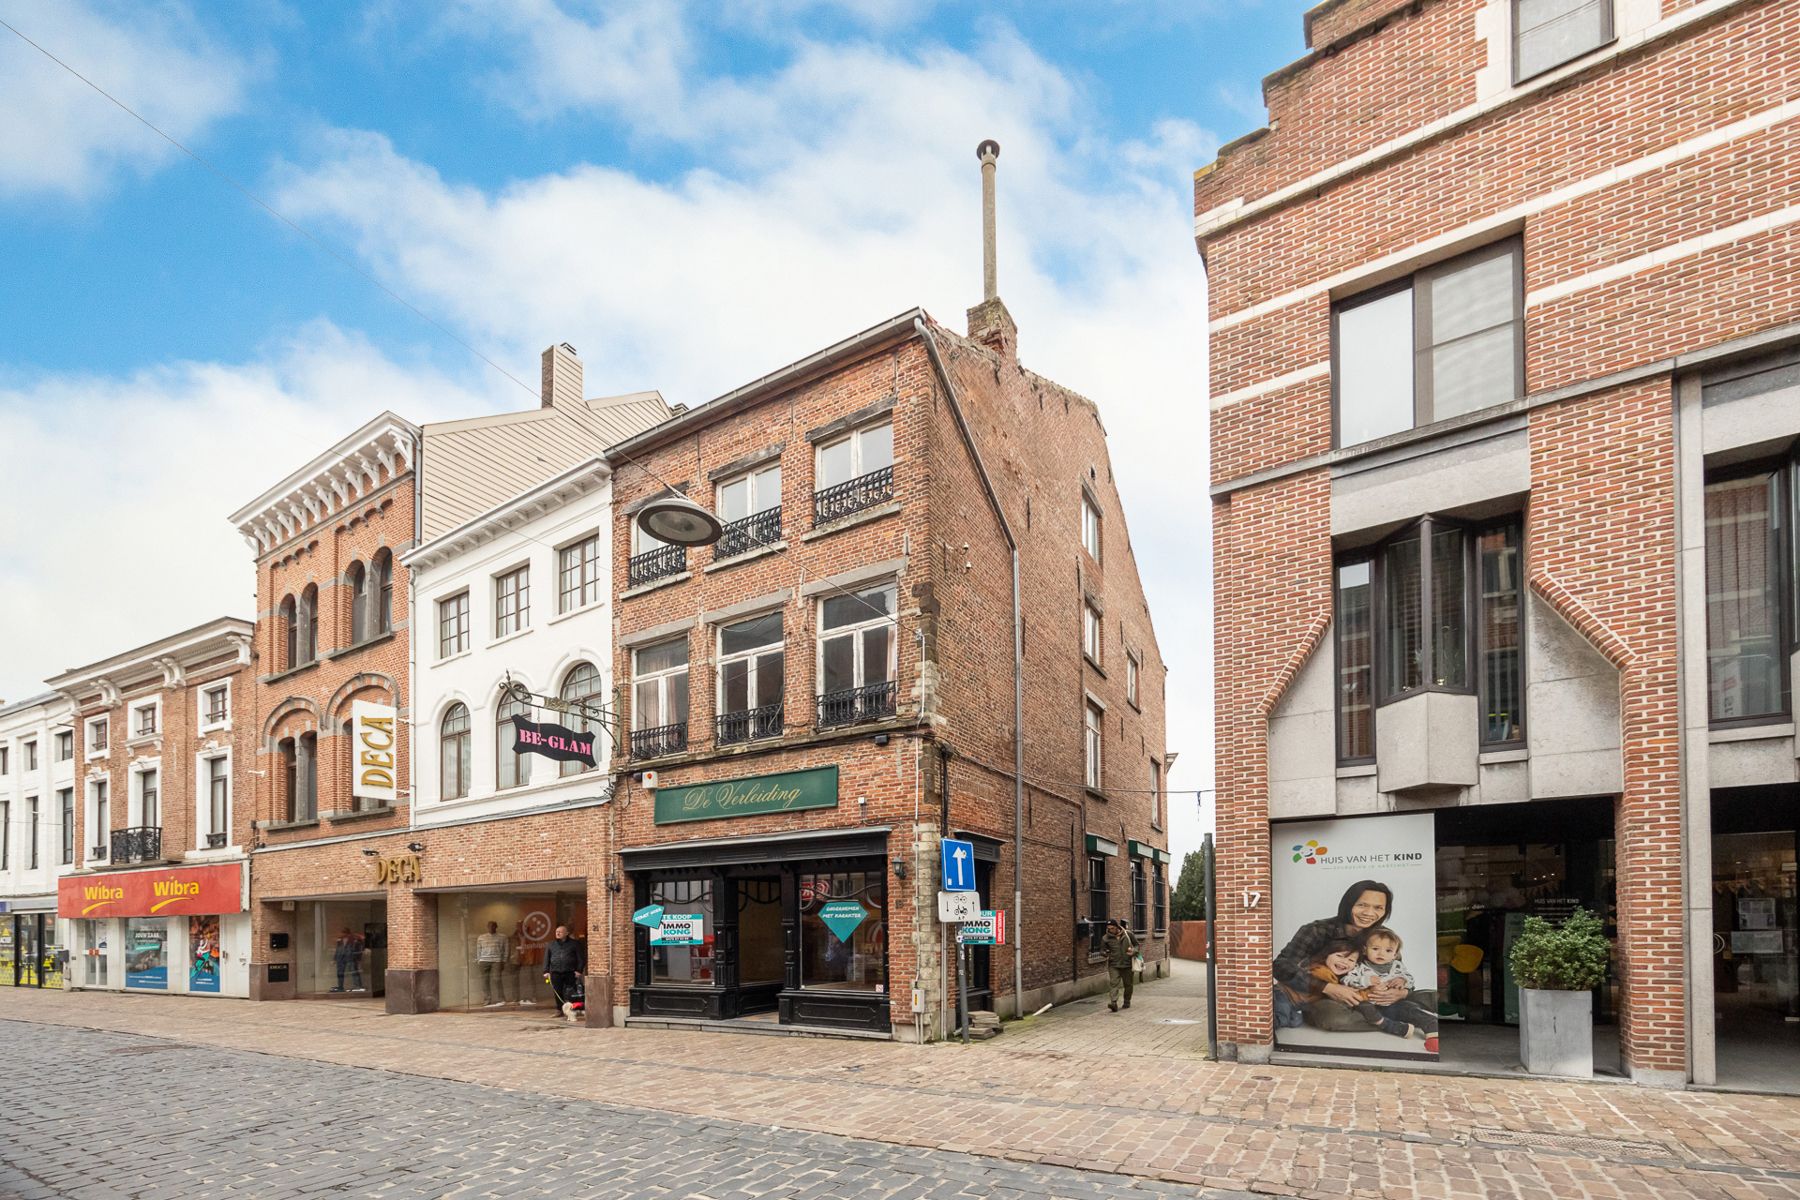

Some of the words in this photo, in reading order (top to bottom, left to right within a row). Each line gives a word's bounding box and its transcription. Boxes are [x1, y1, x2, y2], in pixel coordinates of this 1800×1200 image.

[360, 716, 394, 788] DECA
[519, 729, 592, 756] BE-GLAM
[683, 786, 713, 811] De
[716, 782, 802, 810] Verleiding
[376, 855, 422, 885] DECA
[1320, 856, 1344, 864] HUIS
[1346, 855, 1367, 863] VAN
[1370, 854, 1390, 862] HET
[1393, 852, 1423, 861] KIND
[84, 881, 124, 900] Wibra
[153, 876, 200, 897] Wibra
[1241, 892, 1261, 908] 17
